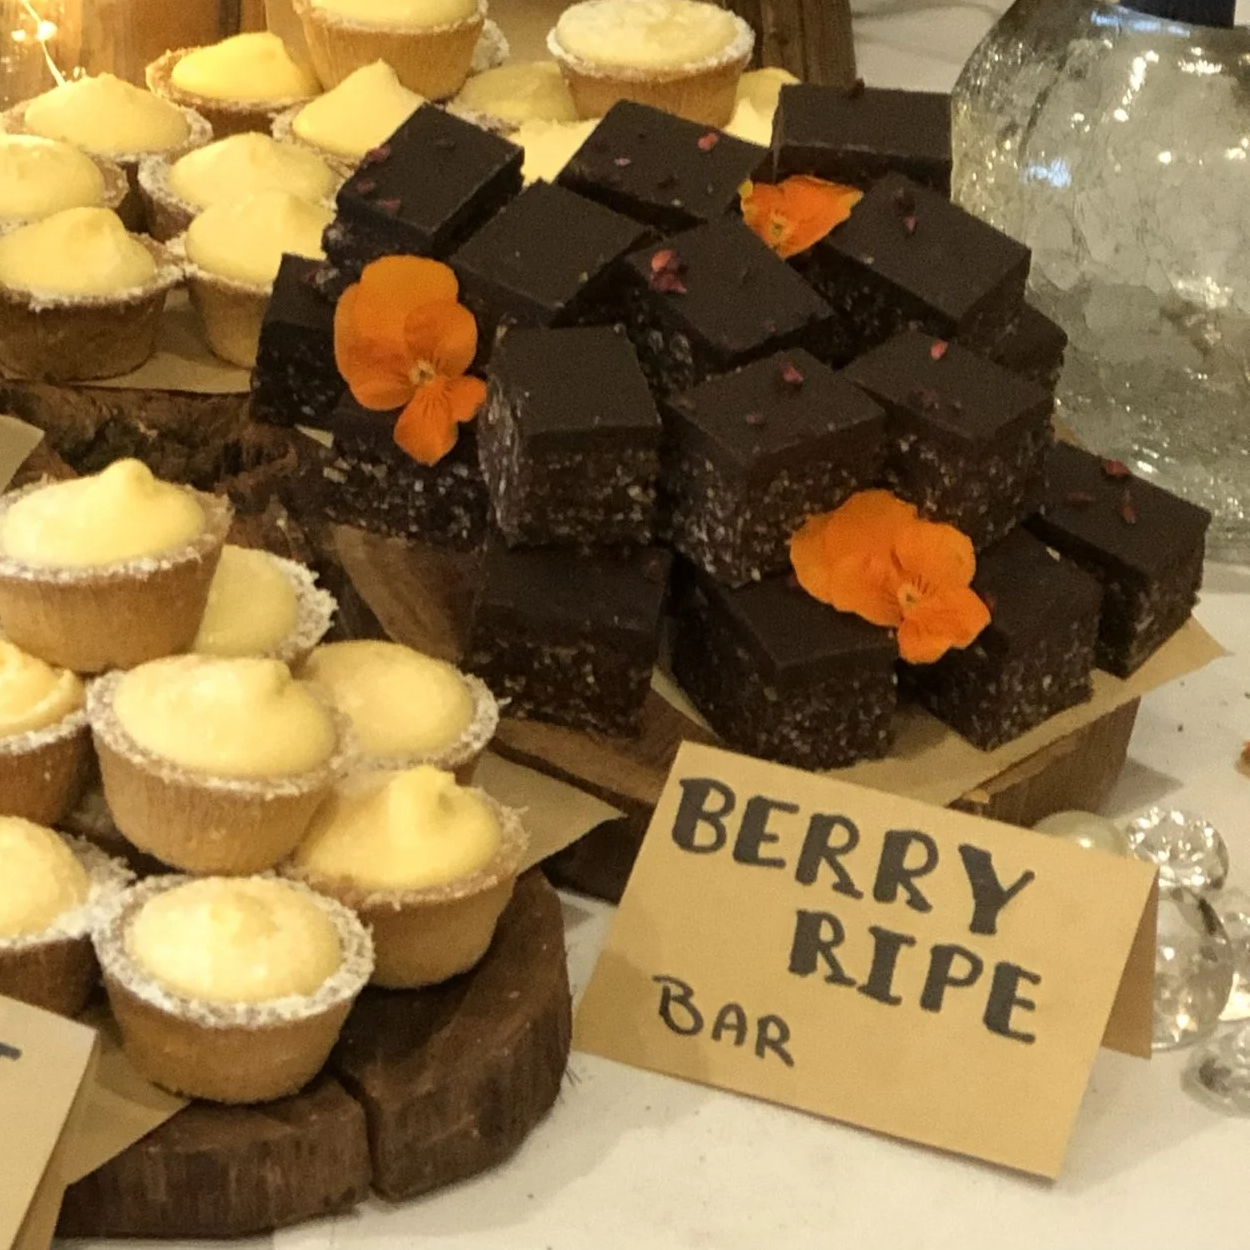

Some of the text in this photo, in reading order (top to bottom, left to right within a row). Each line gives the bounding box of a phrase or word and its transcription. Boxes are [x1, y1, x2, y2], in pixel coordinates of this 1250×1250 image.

[670, 777, 1036, 936] BERRY
[652, 974, 795, 1068] BAR
[786, 908, 1043, 1045] RIPE
